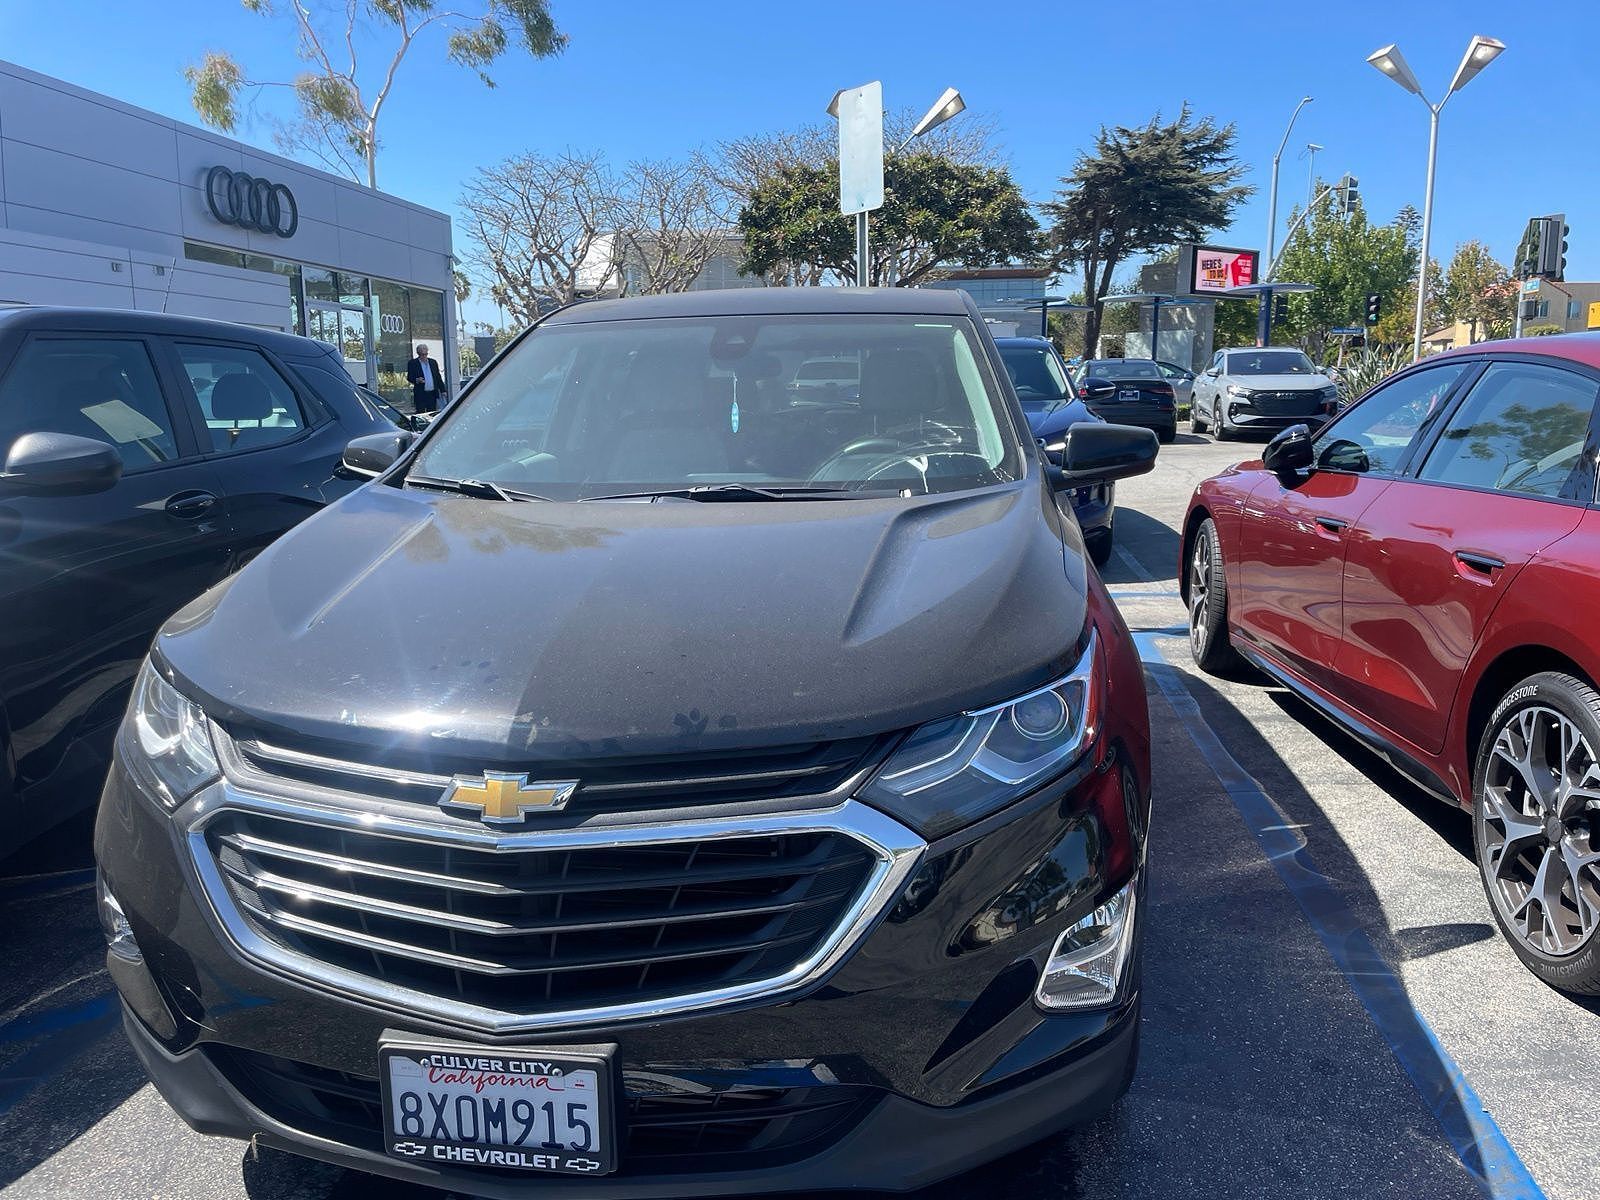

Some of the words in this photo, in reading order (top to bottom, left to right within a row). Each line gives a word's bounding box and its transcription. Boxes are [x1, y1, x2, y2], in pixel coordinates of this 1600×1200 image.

[1202, 259, 1222, 270] HERE'S
[1210, 270, 1216, 279] TO
[1491, 684, 1539, 725] BRIDGESTONE
[430, 1054, 505, 1073] CULVER
[509, 1060, 552, 1074] CITY
[428, 1067, 565, 1093] California
[433, 1145, 560, 1169] CHEVROLET
